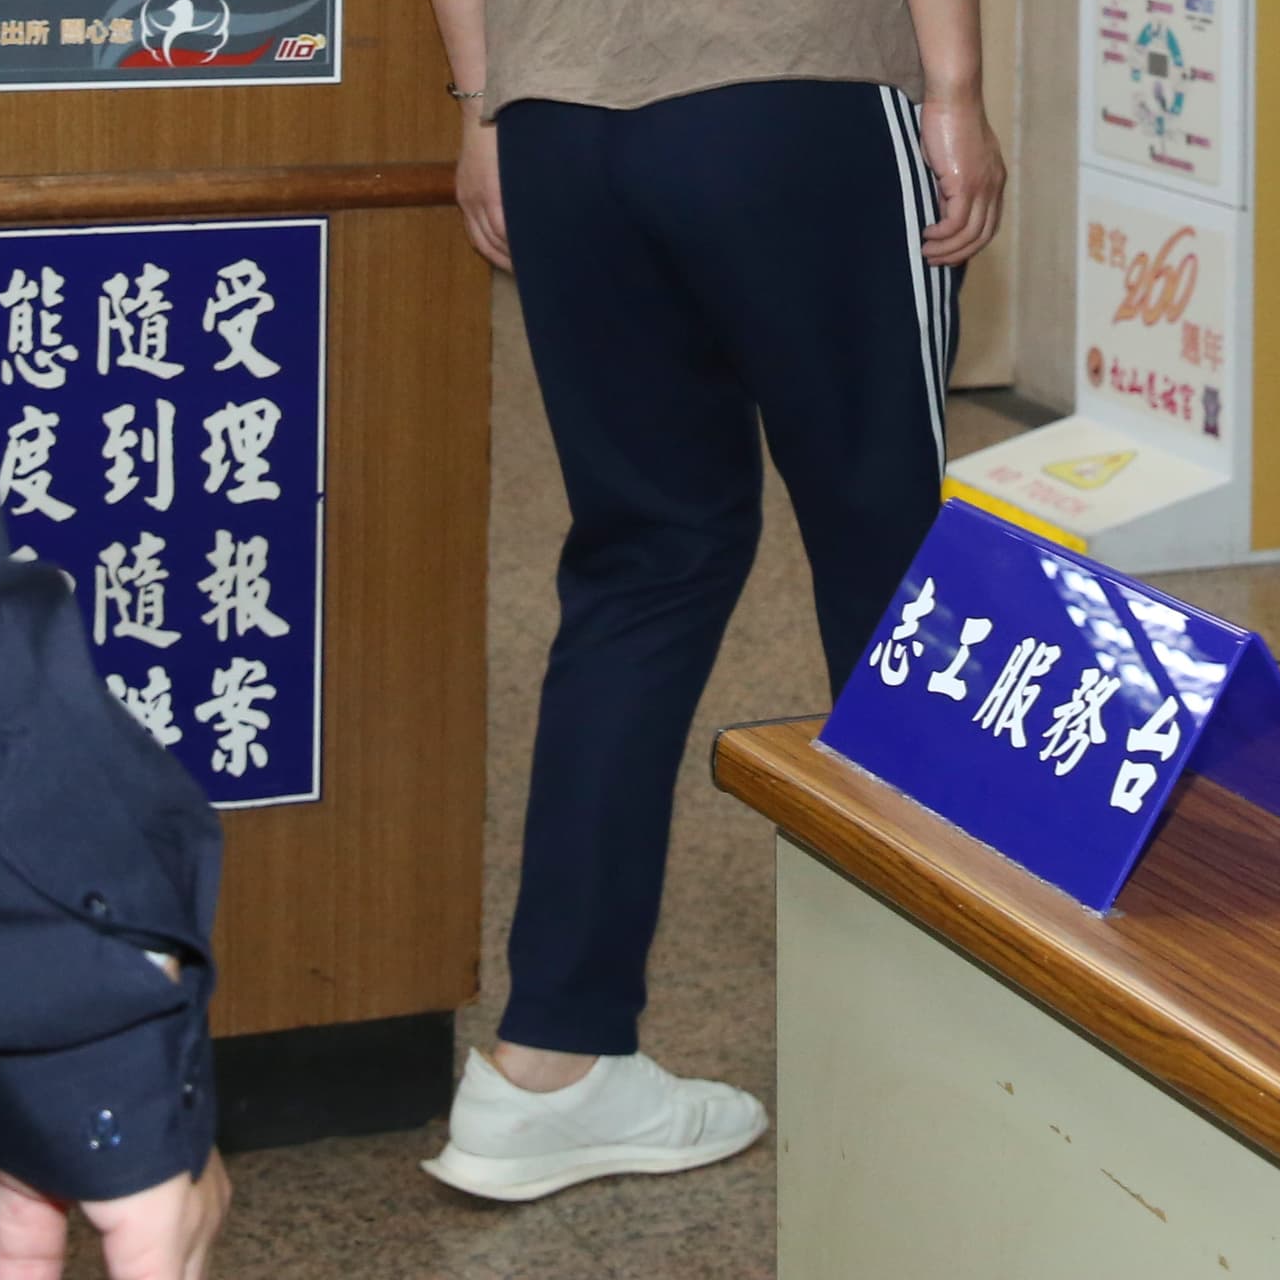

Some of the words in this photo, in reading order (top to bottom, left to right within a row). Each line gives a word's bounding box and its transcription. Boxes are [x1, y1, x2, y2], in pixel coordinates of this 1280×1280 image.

[195, 258, 291, 778] 受理報案
[868, 576, 1182, 814] 志工服務台
